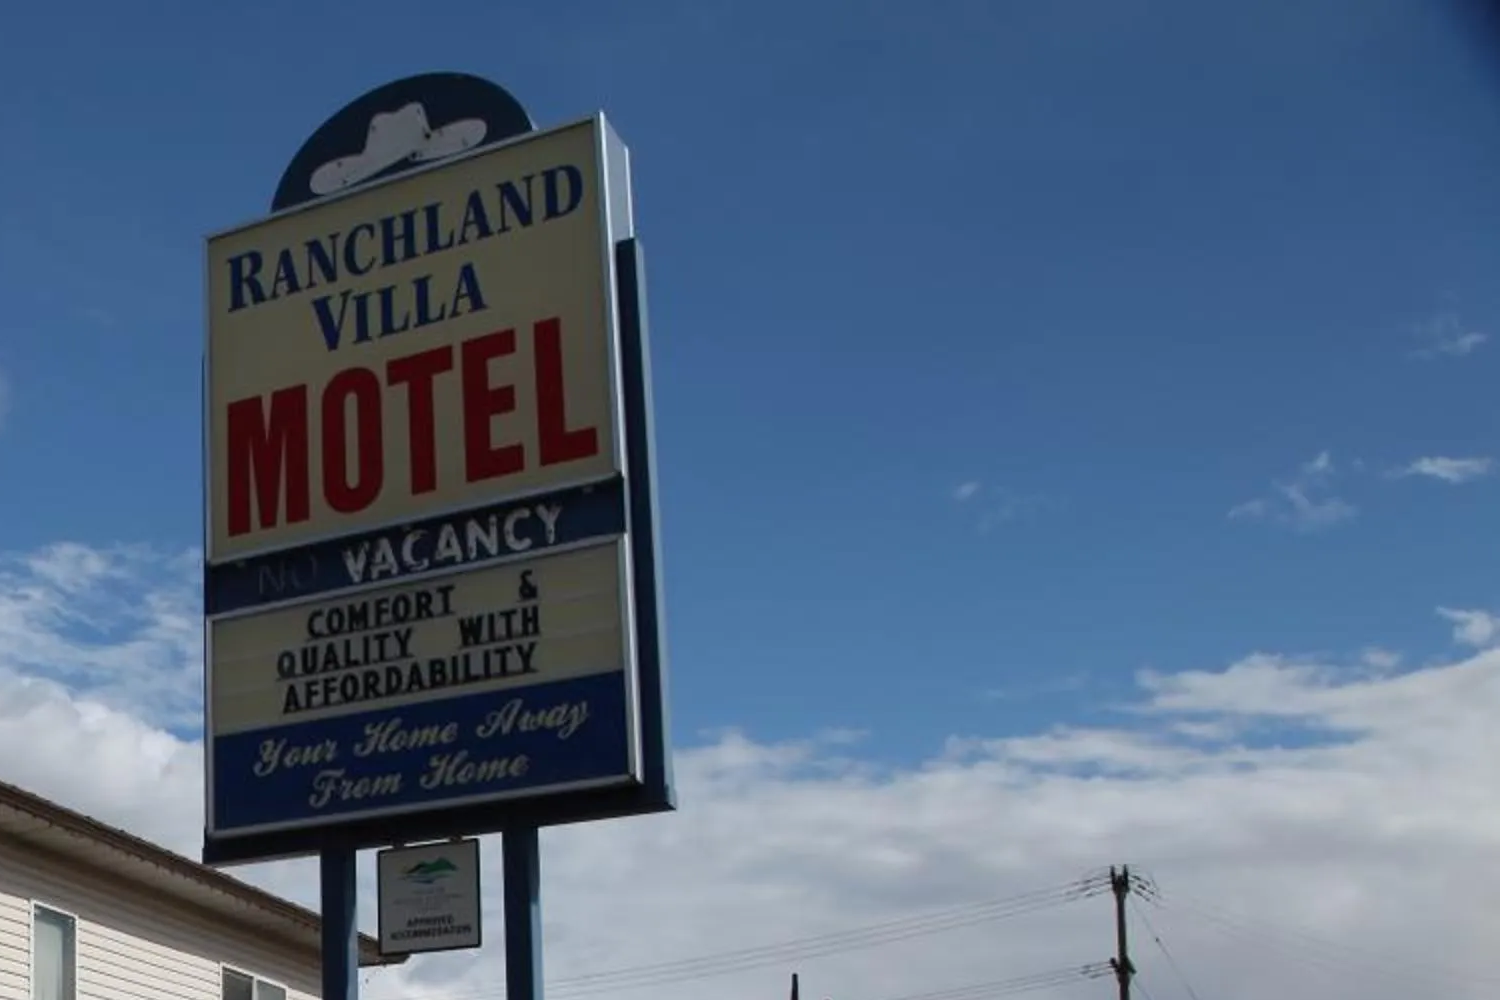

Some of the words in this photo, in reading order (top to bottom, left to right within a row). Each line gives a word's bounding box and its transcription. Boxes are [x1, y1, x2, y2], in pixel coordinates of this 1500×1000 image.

[227, 164, 583, 313] RANCHLAND
[312, 262, 488, 352] VILLA
[227, 316, 598, 537] MOTEL
[342, 504, 563, 584] VACANCY
[277, 628, 414, 680] QUALITY
[458, 606, 541, 649] WITH
[307, 585, 456, 640] COMFORT
[518, 568, 538, 602] &
[282, 642, 538, 714] AFFORDABILITY
[253, 738, 337, 778] Your
[353, 718, 458, 757] Home
[476, 698, 589, 741] Away
[309, 768, 403, 808] From
[419, 751, 529, 791] Home
